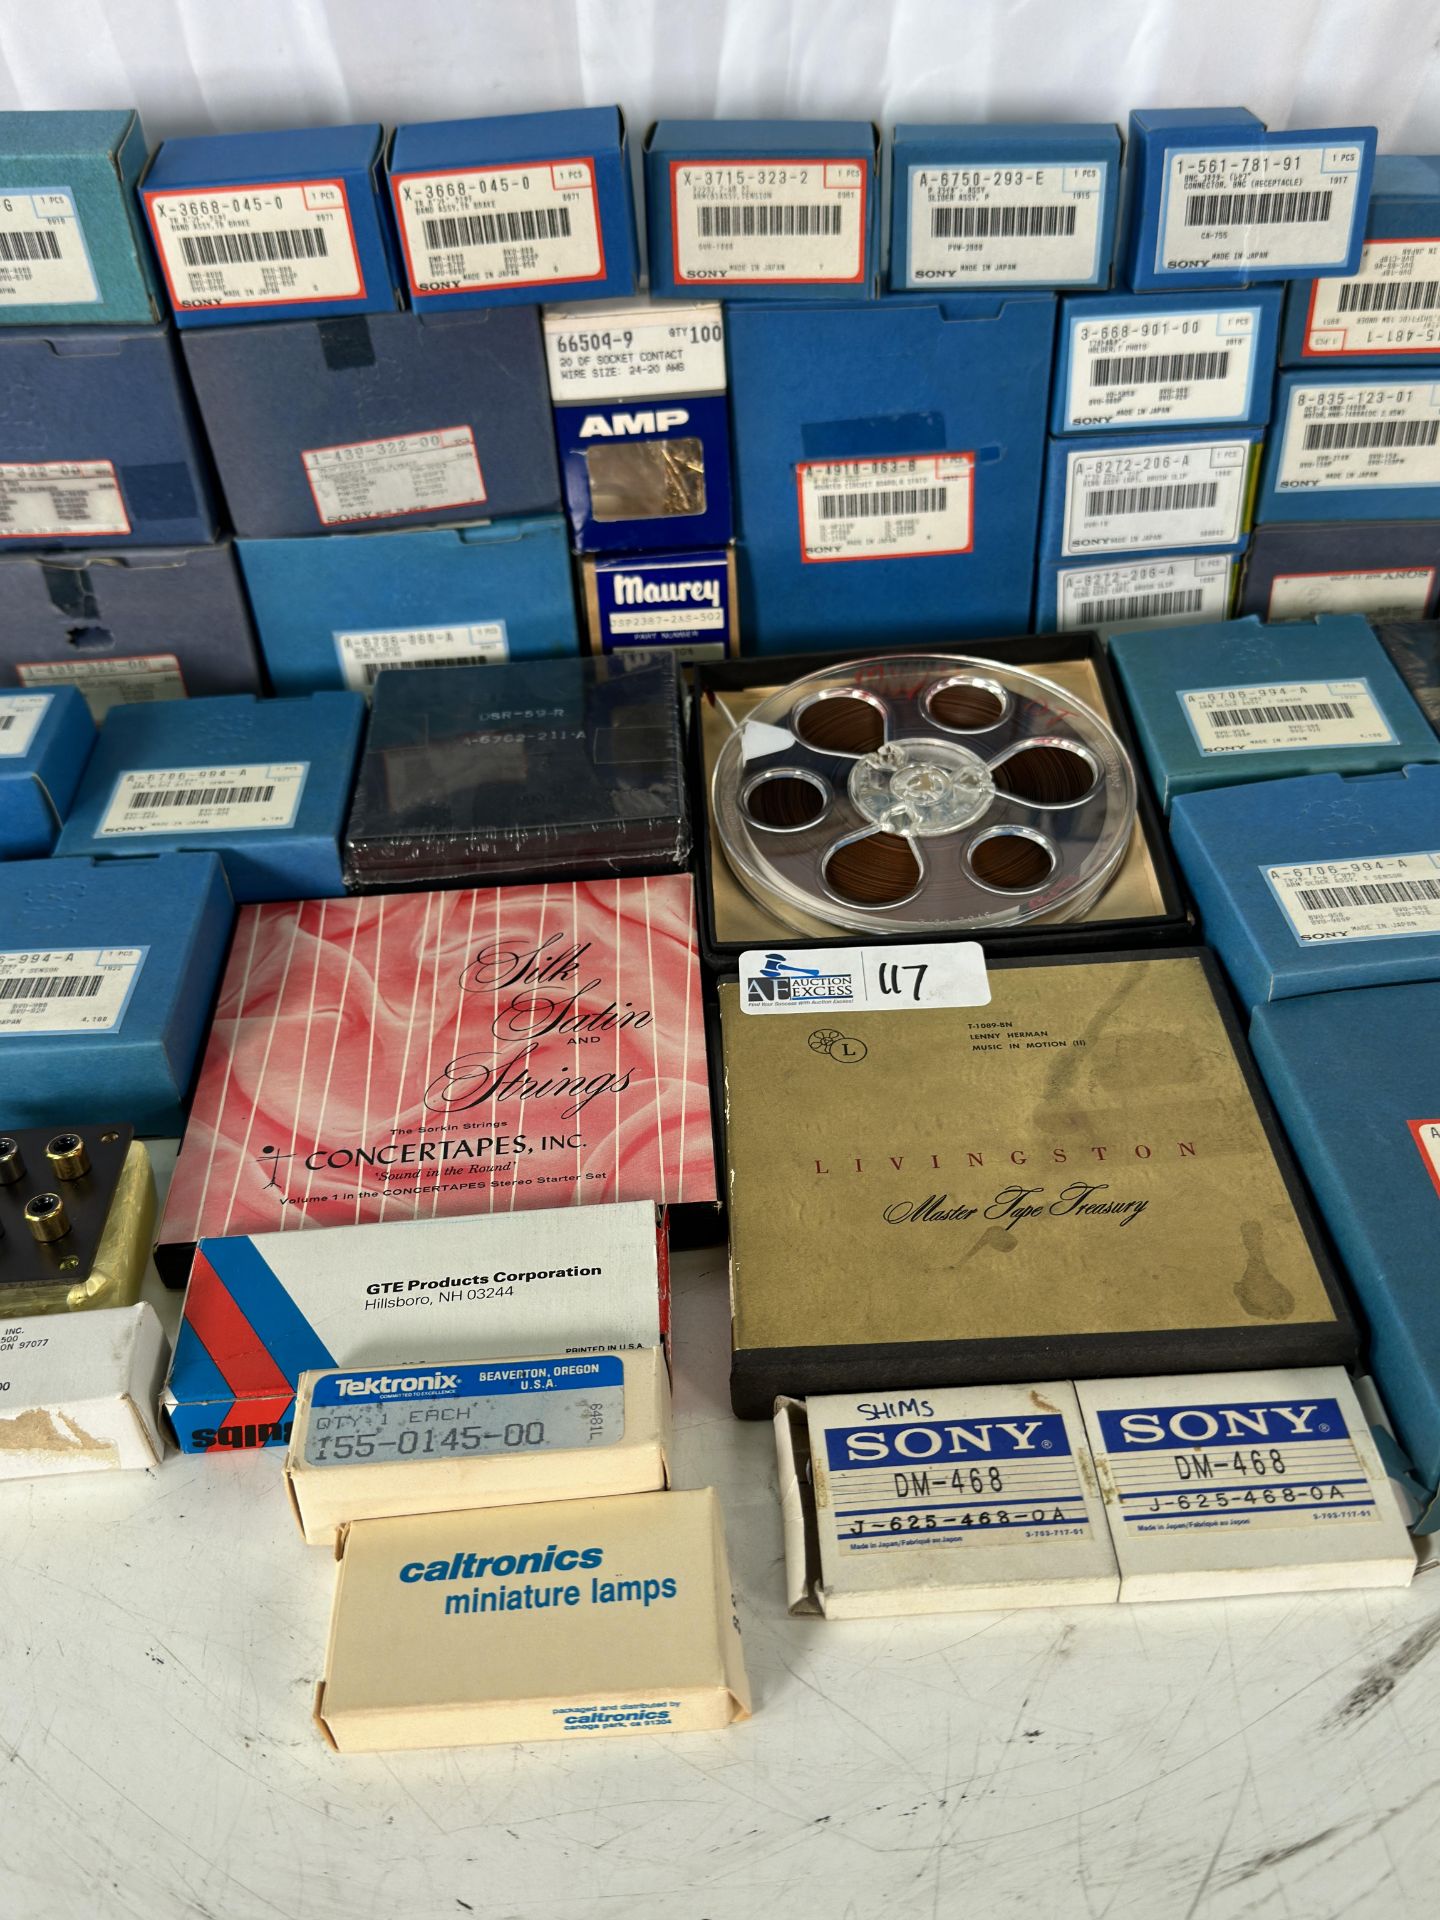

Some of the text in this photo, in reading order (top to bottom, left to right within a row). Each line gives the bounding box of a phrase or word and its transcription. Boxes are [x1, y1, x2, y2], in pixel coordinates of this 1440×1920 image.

[1340, 153, 1355, 161] PCS
[1177, 156, 1301, 174] 1-561-781-91
[684, 171, 808, 186] X-3715-323-2
[920, 171, 1044, 186] A-6750-293-E
[1082, 169, 1096, 178] PCS
[404, 176, 530, 201] X-3668-045-0
[157, 196, 283, 218] X-3668-045-0
[1167, 260, 1210, 269] SONY
[686, 270, 727, 278] SONY
[915, 270, 957, 279] SONY
[419, 280, 461, 292] SONY
[181, 298, 223, 309] SONY
[669, 327, 687, 338] QTY
[690, 326, 722, 344] 100
[1081, 320, 1201, 341] 3-668-901-00
[560, 358, 572, 367] 20
[597, 353, 634, 365] SOCKET
[640, 350, 684, 362] CONTACT
[561, 369, 587, 379] WIRE
[592, 367, 622, 378] SIZE:
[629, 365, 660, 375] 24-20
[578, 407, 689, 438] AMP
[1072, 416, 1113, 426] SONY
[1280, 480, 1319, 489] SONY
[327, 511, 372, 523] SONY
[806, 545, 842, 554] SONY
[1072, 537, 1109, 547] SONY
[613, 574, 720, 607] Maurey
[1203, 745, 1246, 753] SONY
[1300, 931, 1349, 941] SONY
[458, 932, 592, 993] Silk
[792, 977, 852, 987] AUCTION
[792, 985, 853, 998] EXCESS
[492, 978, 654, 1041] Satin
[567, 1036, 601, 1045] AND
[970, 1030, 1048, 1040] LENNY HERMAN
[842, 1043, 856, 1056] L
[972, 1043, 1003, 1051] MUSIC
[1009, 1042, 1020, 1050] IN
[1026, 1040, 1066, 1049] MOTION
[424, 1041, 635, 1120] Strings
[390, 1120, 508, 1136] The Sorkin Strings
[305, 1134, 587, 1171] CONCERTAPES, INC.
[815, 1141, 1197, 1175] LIVINGSTON
[426, 1169, 440, 1178] in
[444, 1166, 464, 1176] the
[279, 1195, 328, 1205] Volume
[343, 1192, 354, 1200] in
[359, 1191, 379, 1199] the
[382, 1181, 486, 1197] CONCERTAPES
[490, 1177, 533, 1188] Stereo
[537, 1174, 581, 1184] Starter
[585, 1171, 607, 1180] Set
[883, 1181, 1149, 1231] Master Tape Treasury
[366, 1265, 602, 1296] GTE Products Corporation
[364, 1285, 514, 1311] Hillsboro, NH 03244
[5, 1326, 24, 1335] INC.
[19, 1338, 49, 1349] 97077
[565, 1342, 645, 1353] PRINTED IN U.S.A.
[479, 1364, 599, 1382] BEAVERTON, OREGON
[336, 1371, 458, 1397] Tektronix
[521, 1379, 557, 1390] U.S.A.
[381, 1413, 388, 1425] 1
[409, 1408, 470, 1423] EACH
[857, 1398, 934, 1421] SHIMS
[1120, 1405, 1317, 1443] SONY
[315, 1421, 545, 1461] 155-0145-00
[846, 1421, 1043, 1462] SONY
[1174, 1449, 1286, 1480] DM-468
[894, 1466, 1003, 1498] DM-468
[400, 1544, 603, 1584] caltronics
[444, 1577, 677, 1615] miniature lamps
[553, 1705, 597, 1714] packaged
[620, 1702, 667, 1710] distributed
[564, 1709, 669, 1724] caltronics
[602, 1721, 627, 1729] park,
